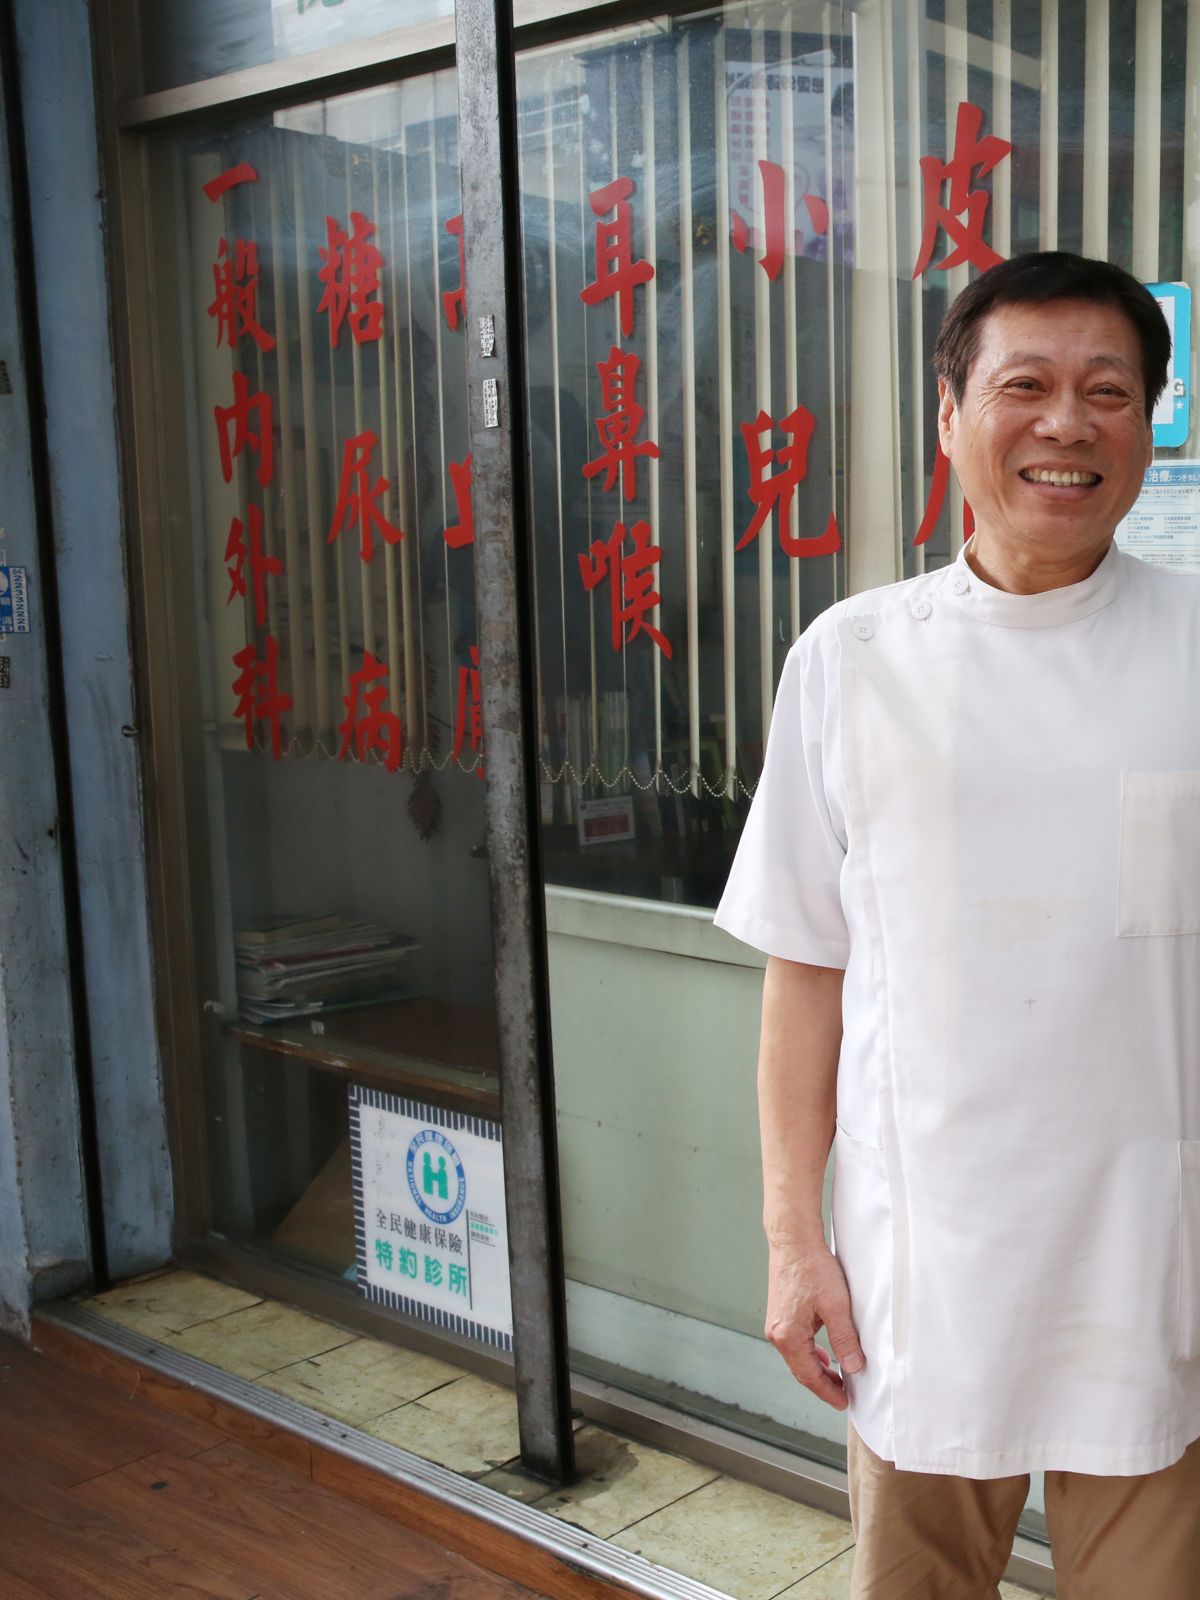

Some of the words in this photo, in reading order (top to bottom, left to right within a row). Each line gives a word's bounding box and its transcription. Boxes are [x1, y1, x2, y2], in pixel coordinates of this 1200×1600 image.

[317, 211, 404, 774] 糖尿病
[578, 176, 672, 660] 耳鼻喉
[374, 1237, 468, 1298] 特約診所
[375, 1208, 463, 1256] 全民健康保險
